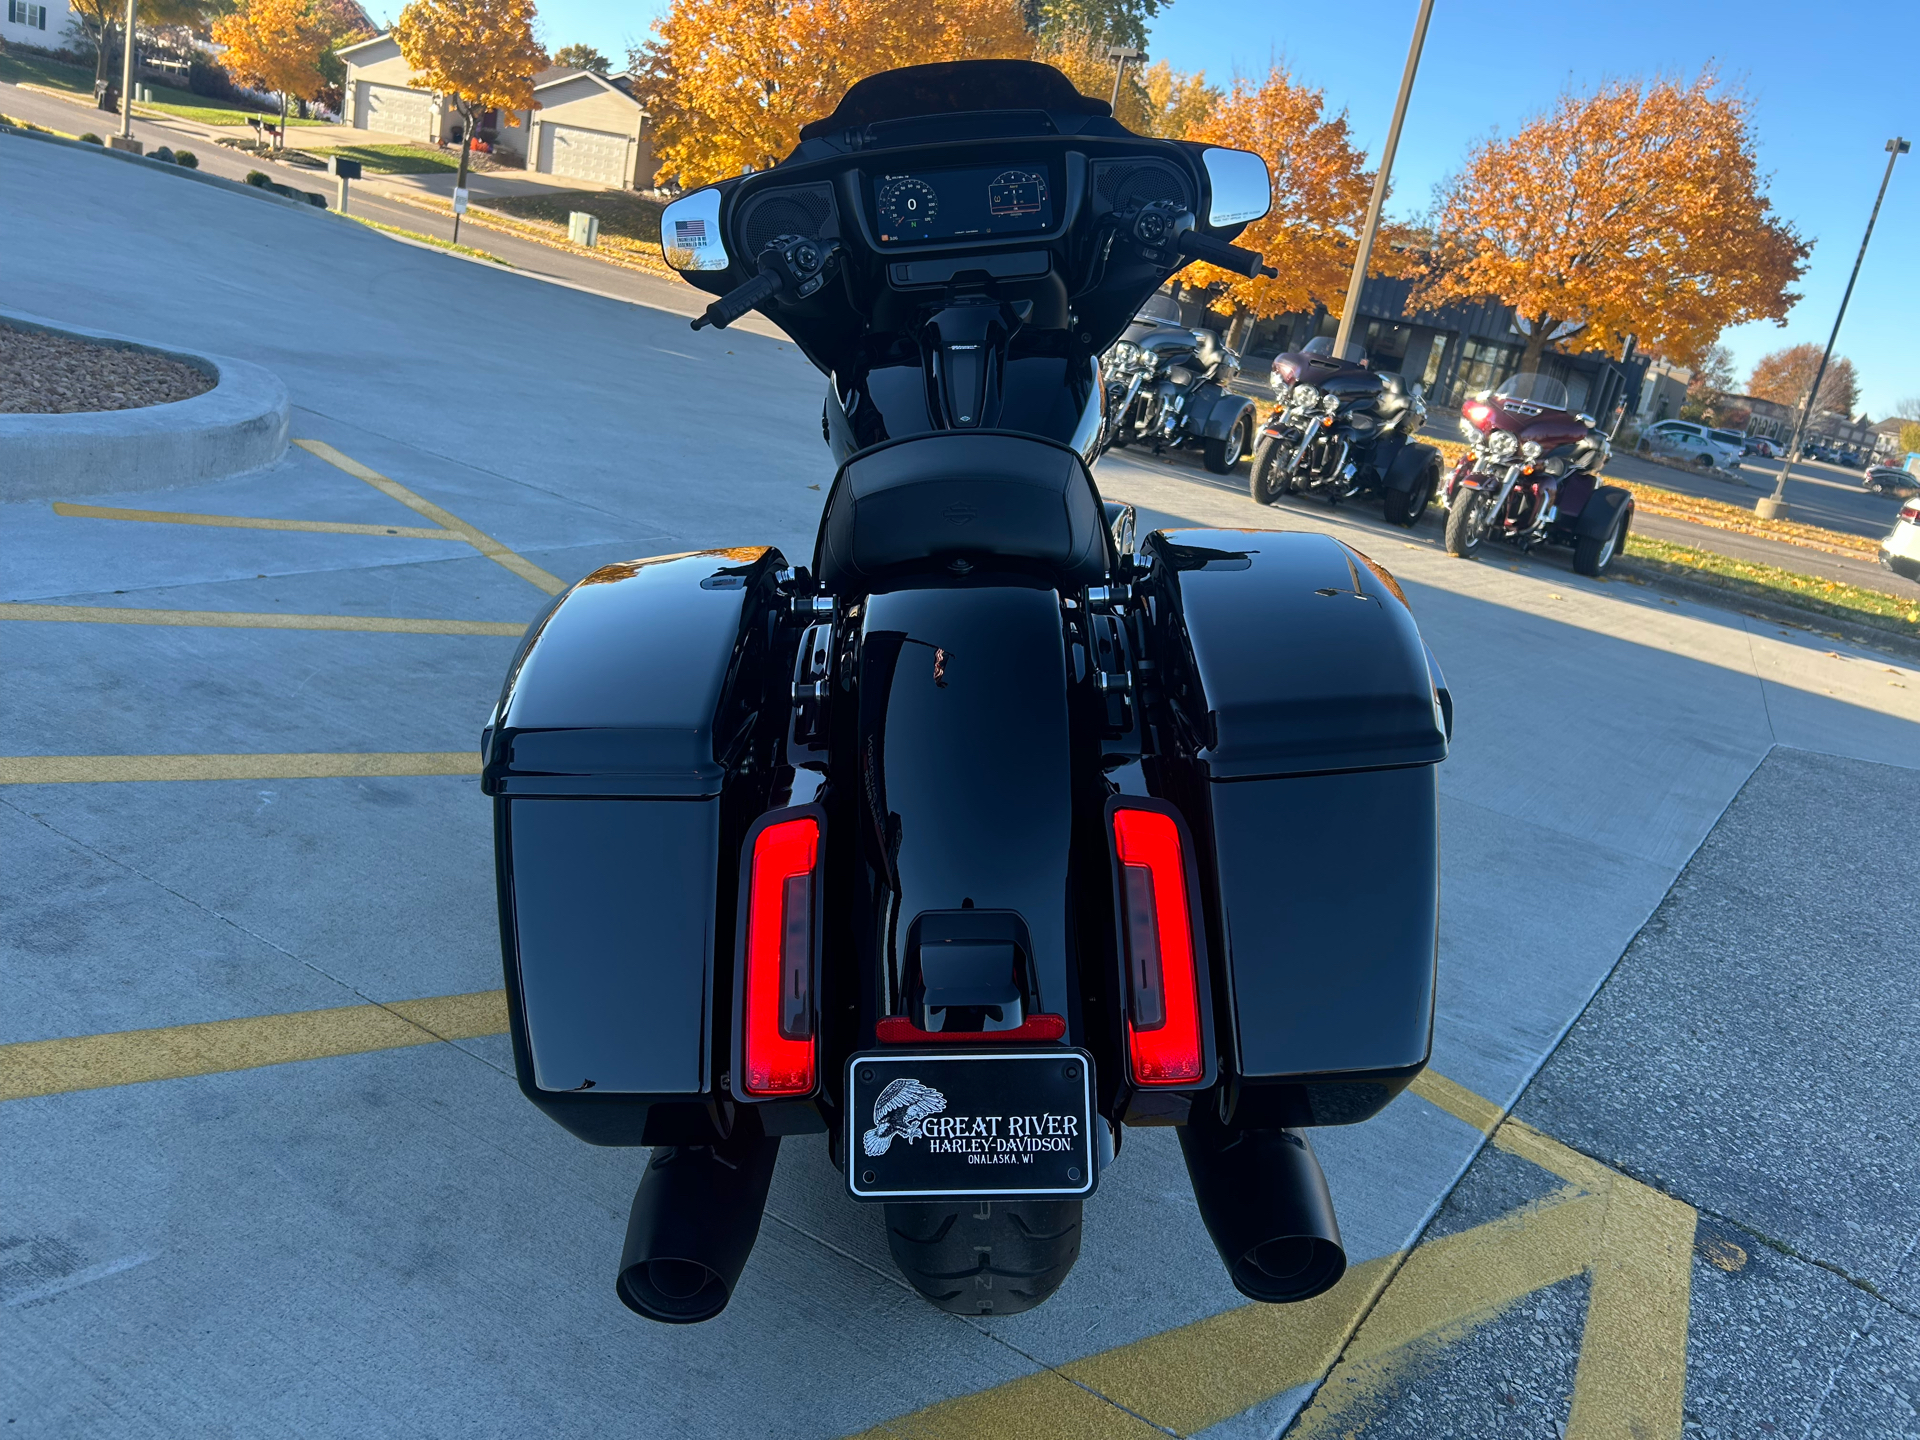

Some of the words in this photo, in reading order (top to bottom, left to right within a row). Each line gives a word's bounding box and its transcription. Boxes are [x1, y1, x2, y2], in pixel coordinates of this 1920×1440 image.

[908, 198, 917, 210] 0
[922, 1116, 1002, 1138] GREAT
[1008, 1112, 1078, 1137] RIVER
[930, 1136, 1071, 1153] HARLEY-DAVIDSON
[968, 1154, 1019, 1164] ONALASKA,
[1022, 1153, 1034, 1164] WI
